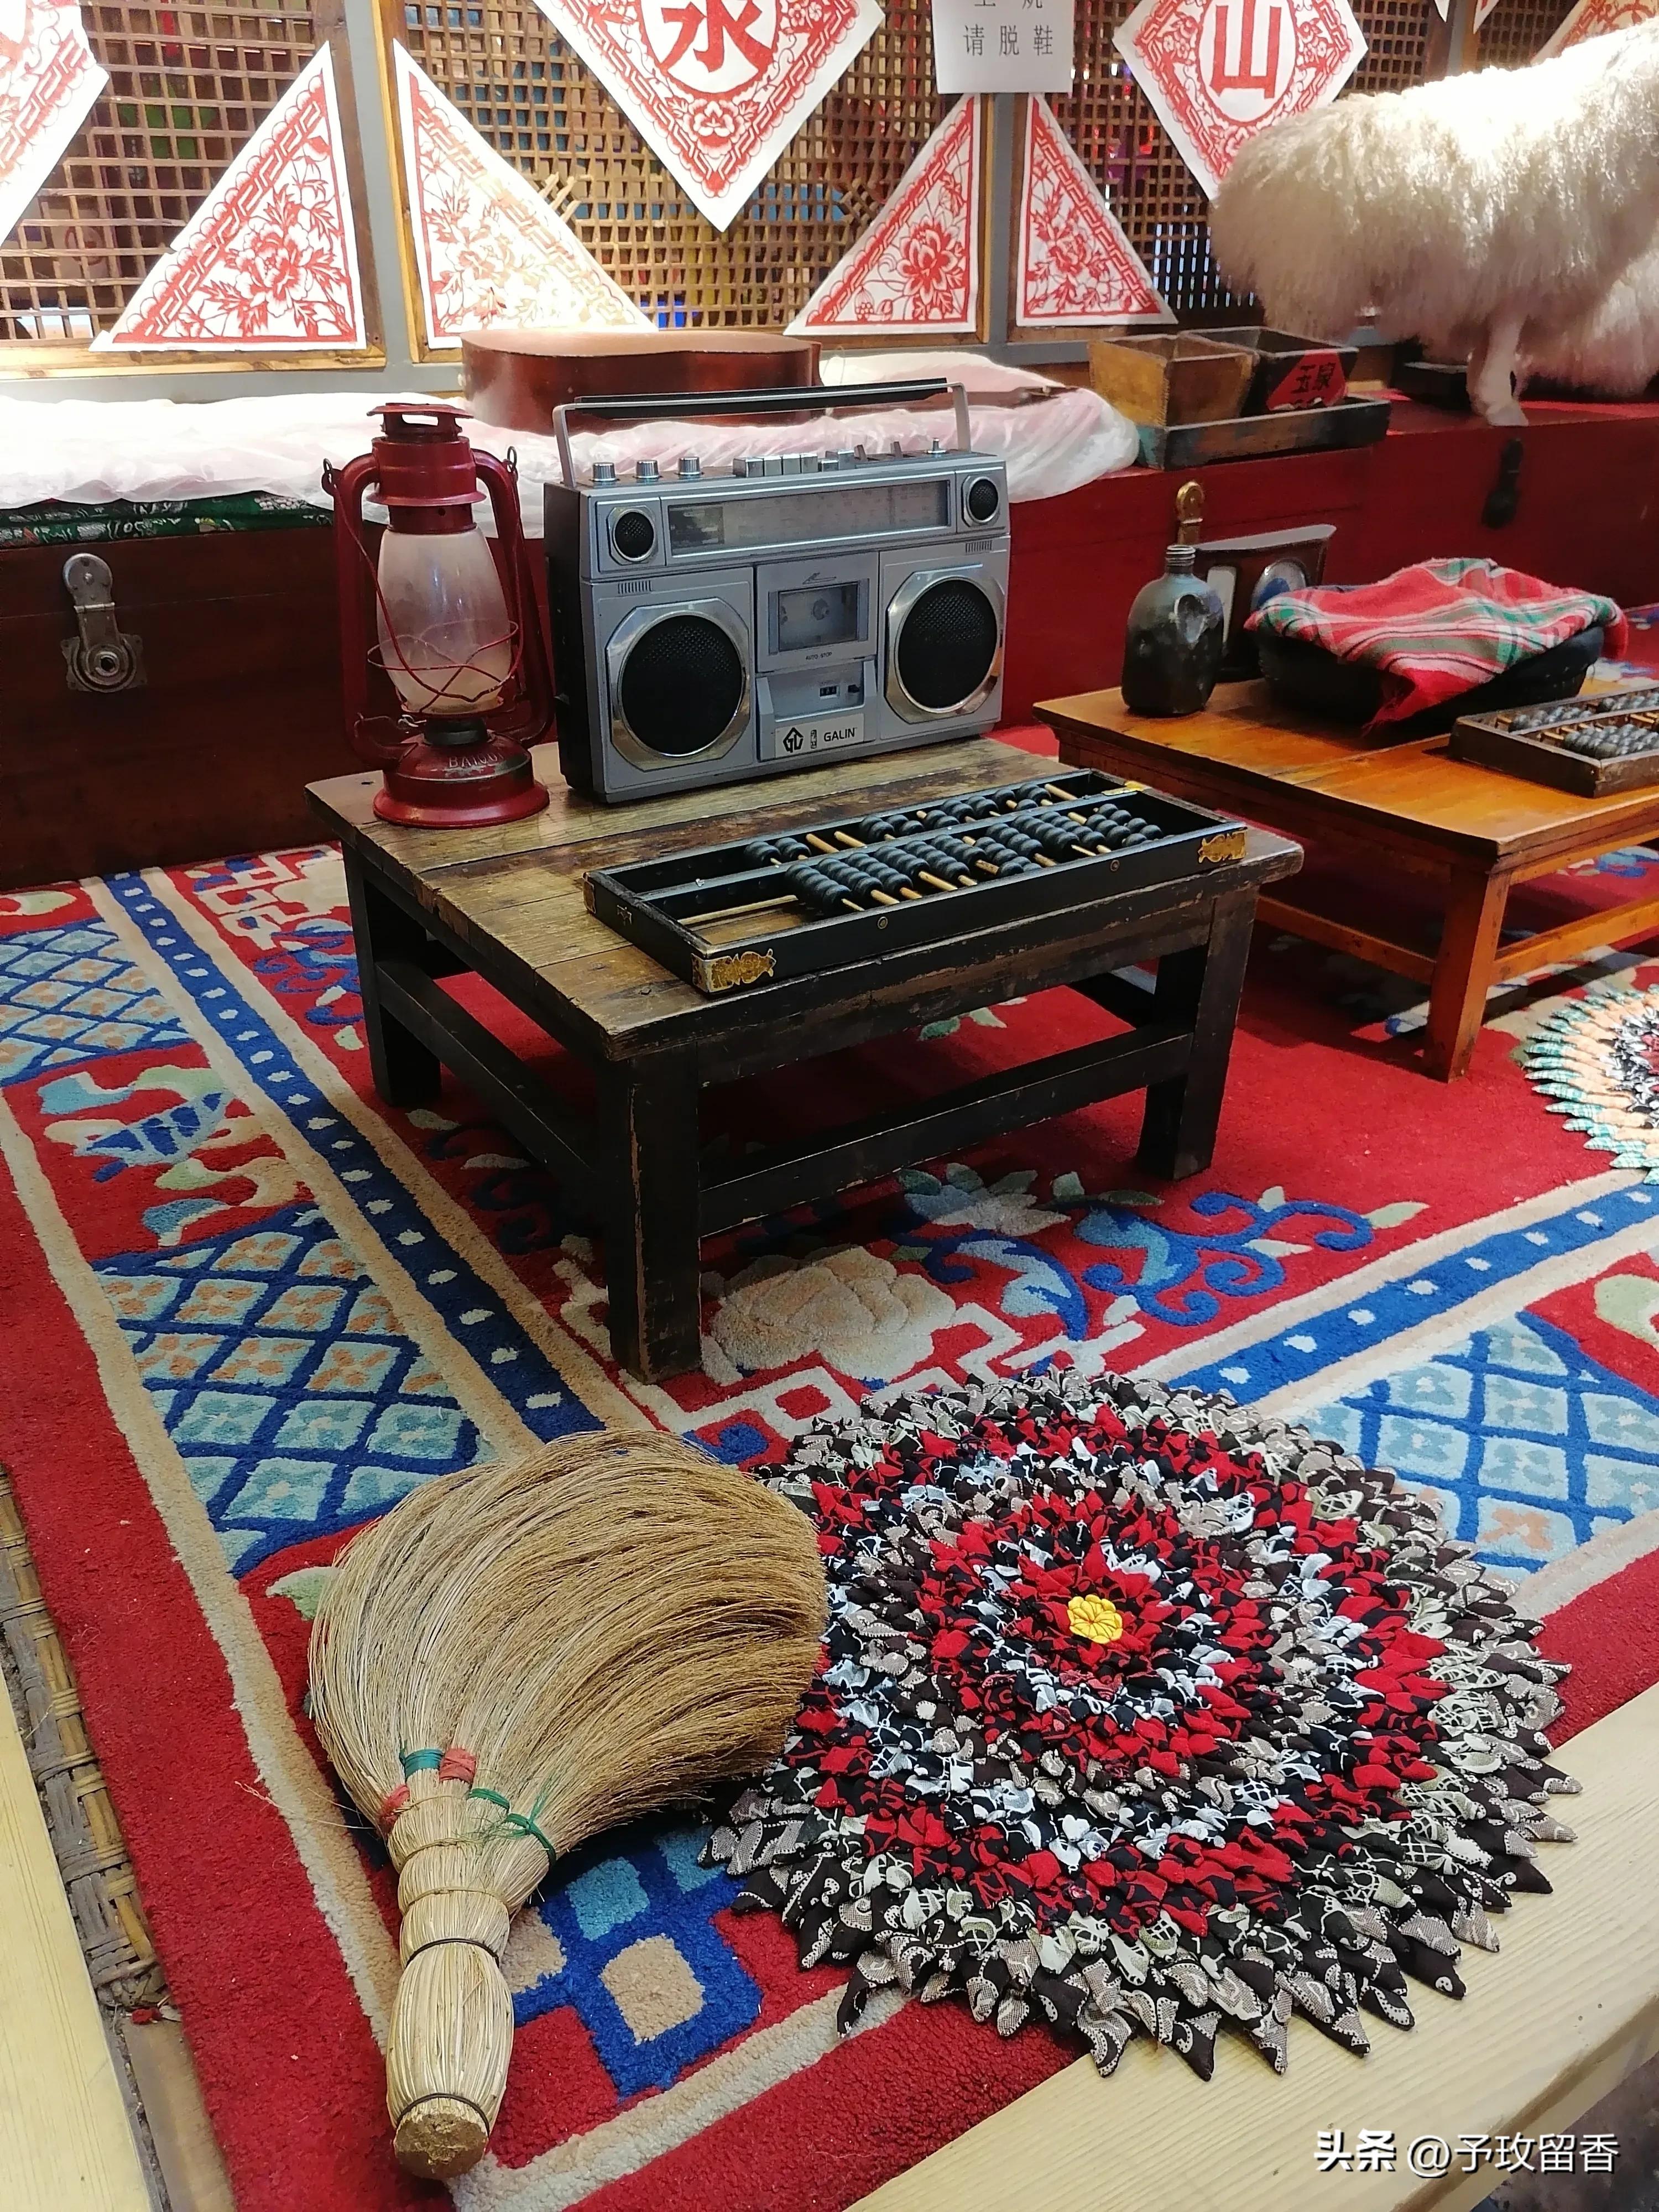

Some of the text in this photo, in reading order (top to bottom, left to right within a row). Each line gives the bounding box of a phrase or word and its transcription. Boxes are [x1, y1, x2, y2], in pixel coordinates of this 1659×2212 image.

[963, 24, 1053, 56] 请脱鞋
[1209, 0, 1282, 99] 山
[824, 728, 855, 742] GALIN
